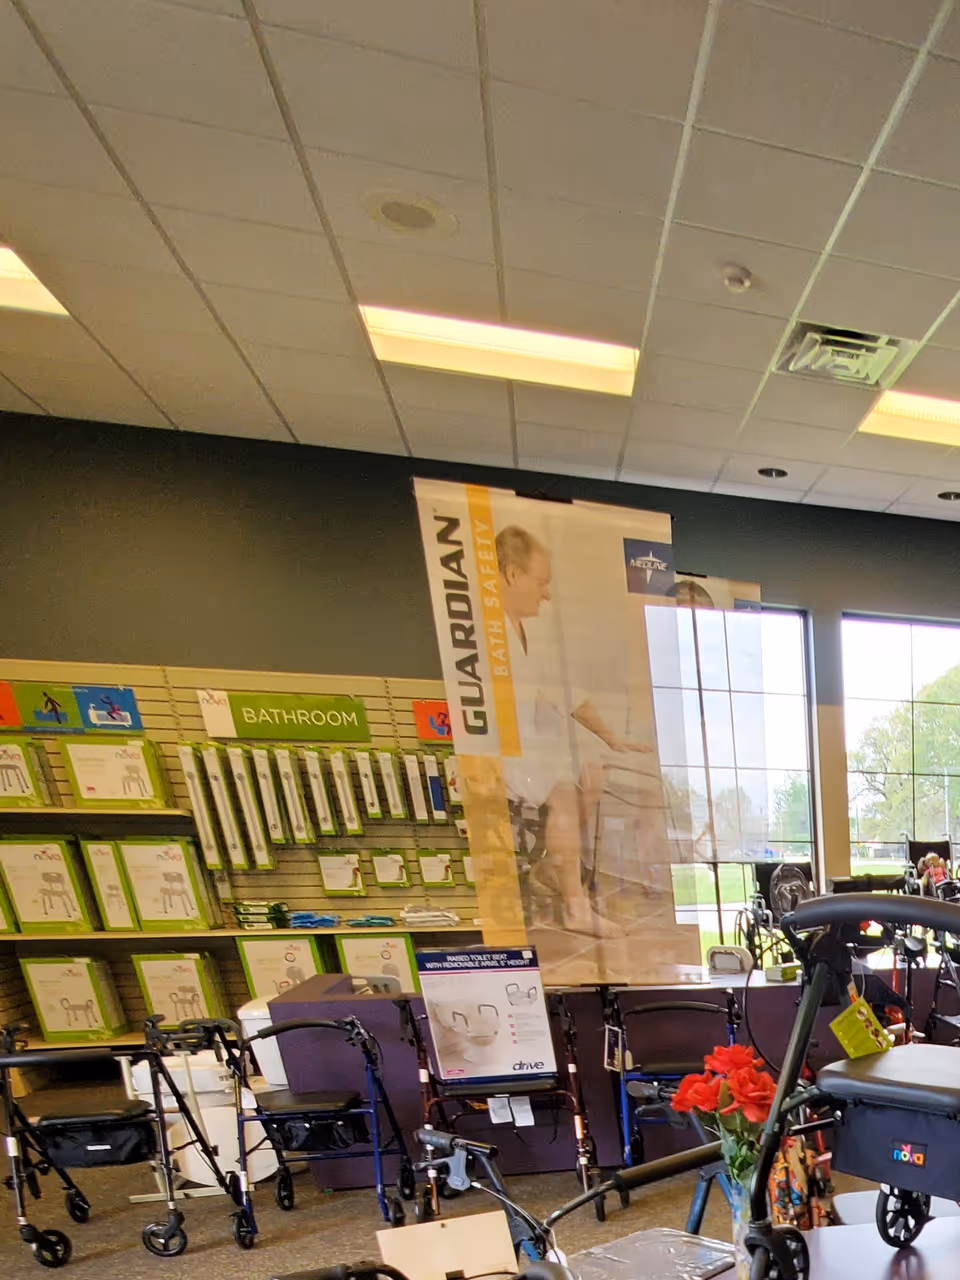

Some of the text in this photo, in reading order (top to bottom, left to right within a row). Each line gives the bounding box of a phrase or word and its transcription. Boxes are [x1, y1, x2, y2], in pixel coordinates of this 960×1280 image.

[629, 557, 669, 571] MEDLINE
[473, 520, 510, 677] BATH SAFETY
[433, 515, 489, 735] GUARDIAN
[242, 707, 359, 727] BATHROOM
[115, 748, 140, 761] nova
[33, 850, 62, 862] nova
[156, 850, 182, 862] nova
[512, 1060, 545, 1071] drive
[893, 1147, 924, 1166] nova
